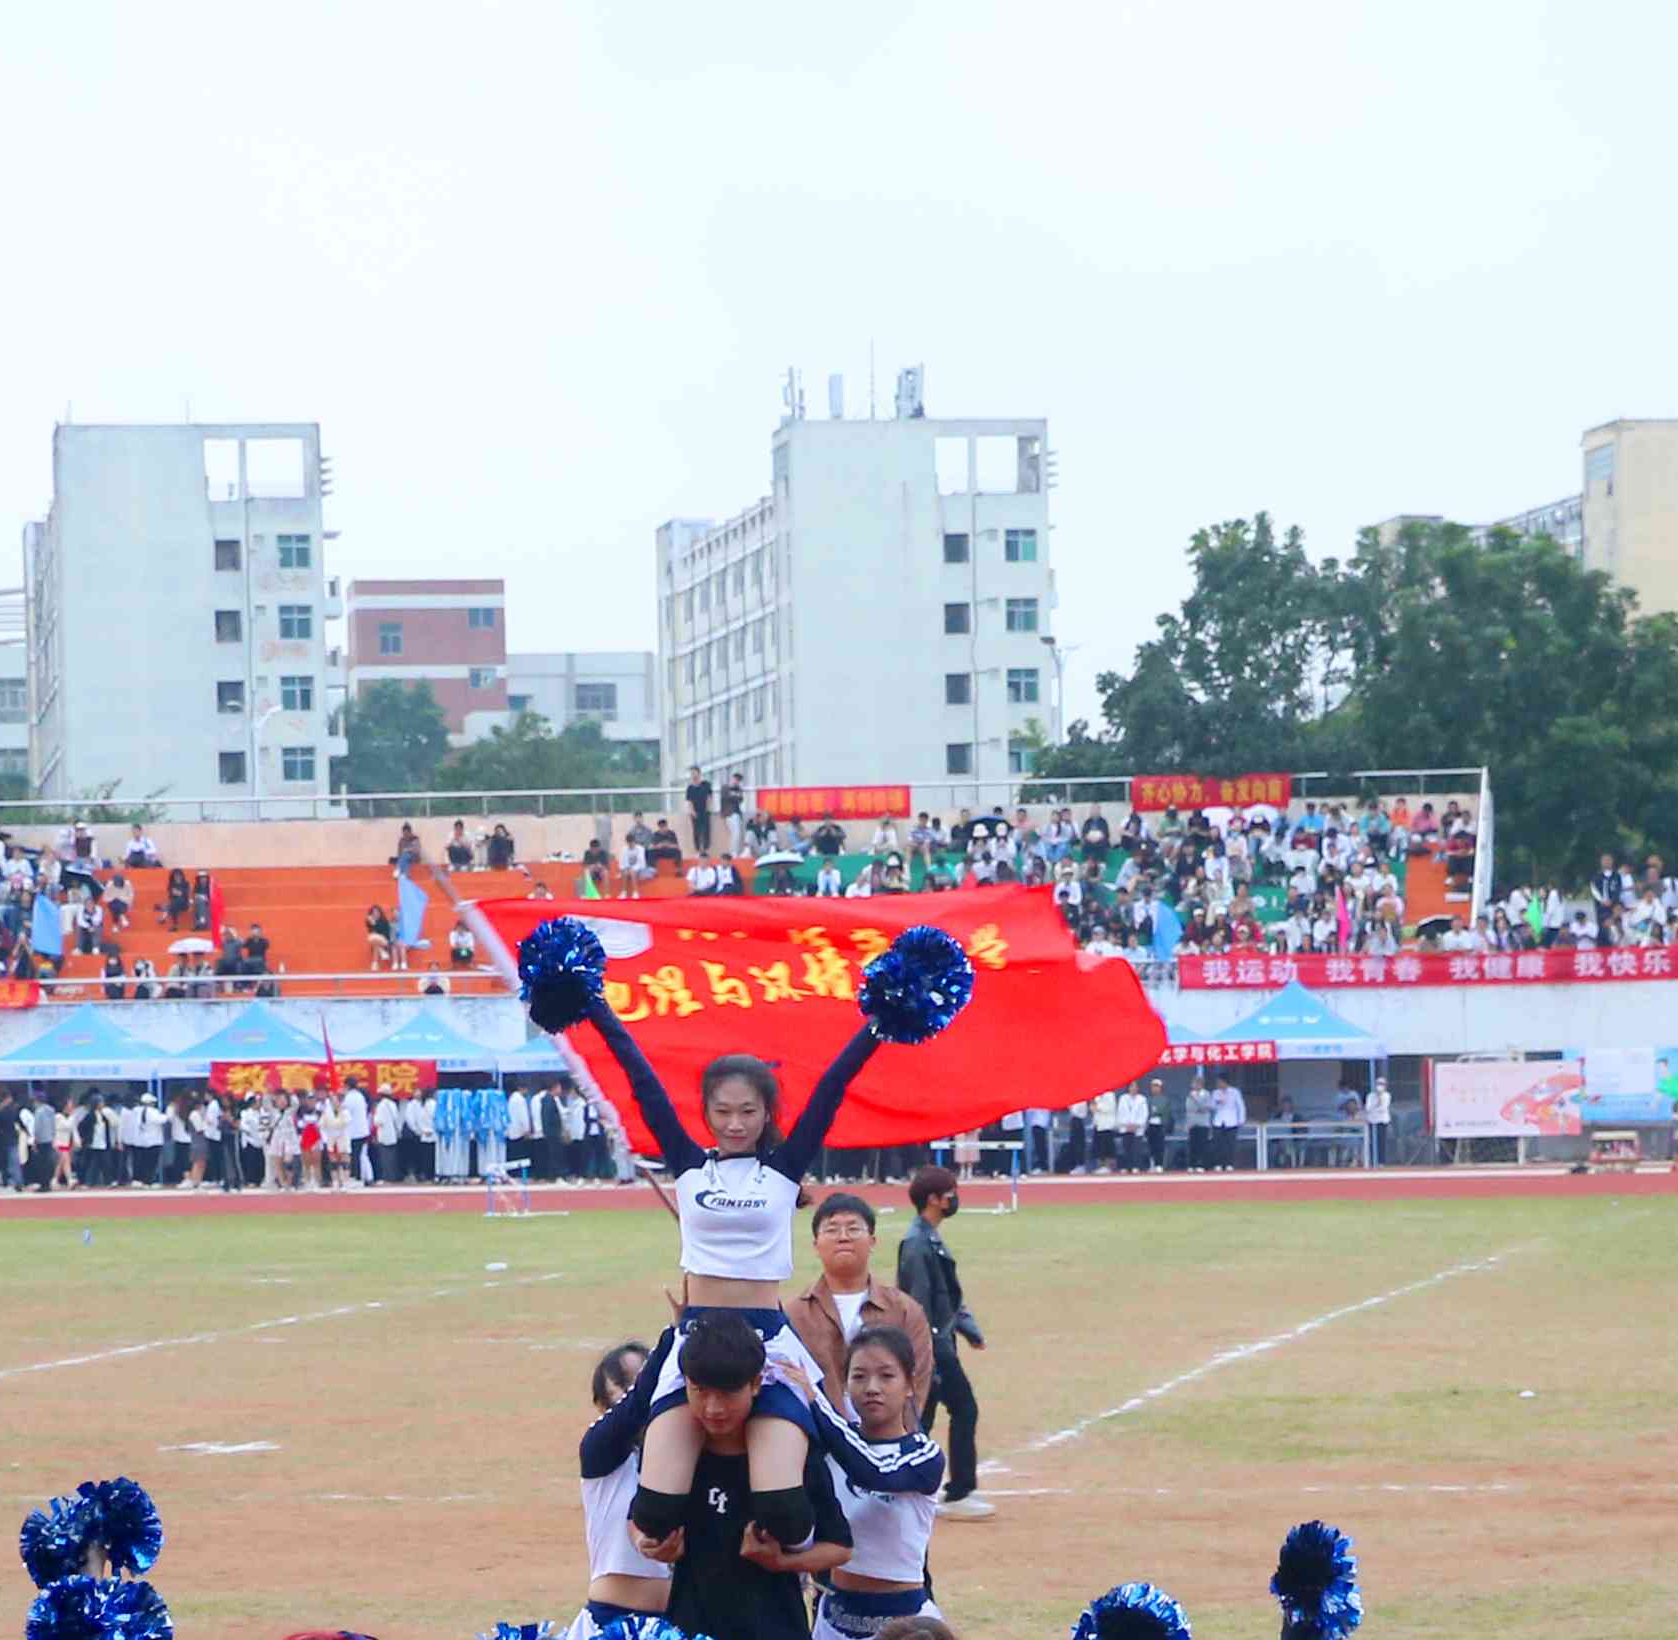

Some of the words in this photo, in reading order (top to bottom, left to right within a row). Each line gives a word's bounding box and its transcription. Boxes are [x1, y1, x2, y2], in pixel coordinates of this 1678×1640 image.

[1202, 958, 1299, 986] 我运动
[1325, 956, 1422, 984] 我青春
[1449, 954, 1546, 980] 我健康
[1574, 950, 1673, 977] 我快乐
[226, 1061, 420, 1095] 教育学院
[710, 1197, 768, 1209] FANTASY
